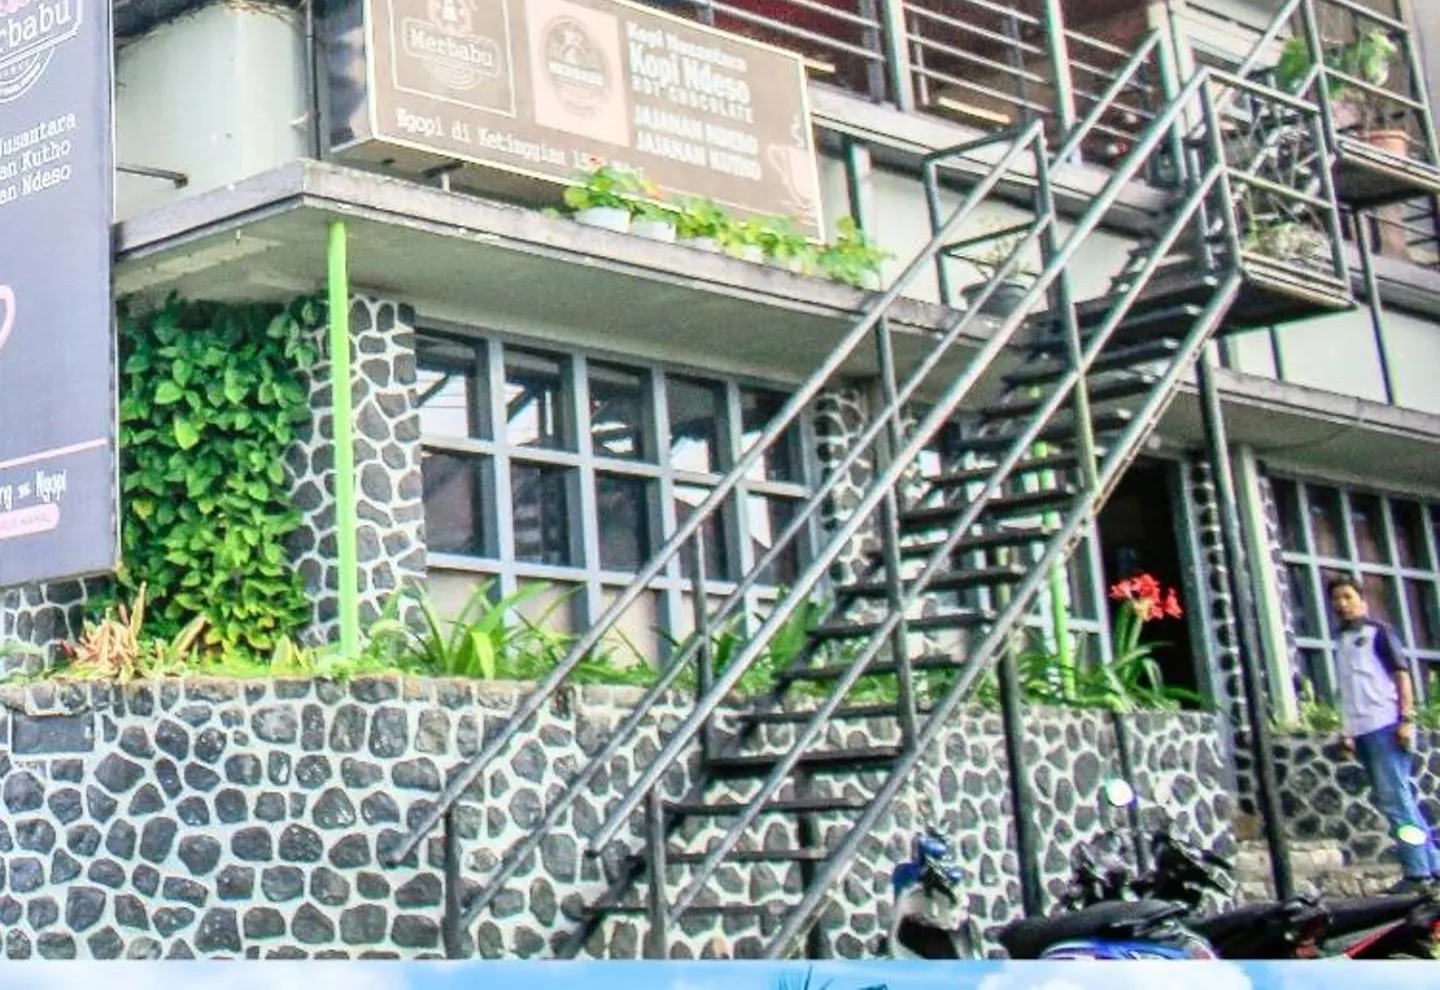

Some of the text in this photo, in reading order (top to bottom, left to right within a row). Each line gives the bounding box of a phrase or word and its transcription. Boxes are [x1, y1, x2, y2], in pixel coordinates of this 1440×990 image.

[409, 27, 493, 67] Merbabu
[629, 40, 681, 90] Kopi
[682, 57, 752, 105] Ndeso
[21, 139, 71, 172] Kutho
[395, 107, 445, 138] Ngopi
[451, 120, 471, 143] di
[477, 126, 568, 168] Ketinggian
[20, 162, 71, 196] Ndeso
[35, 468, 67, 503] Ngopi
